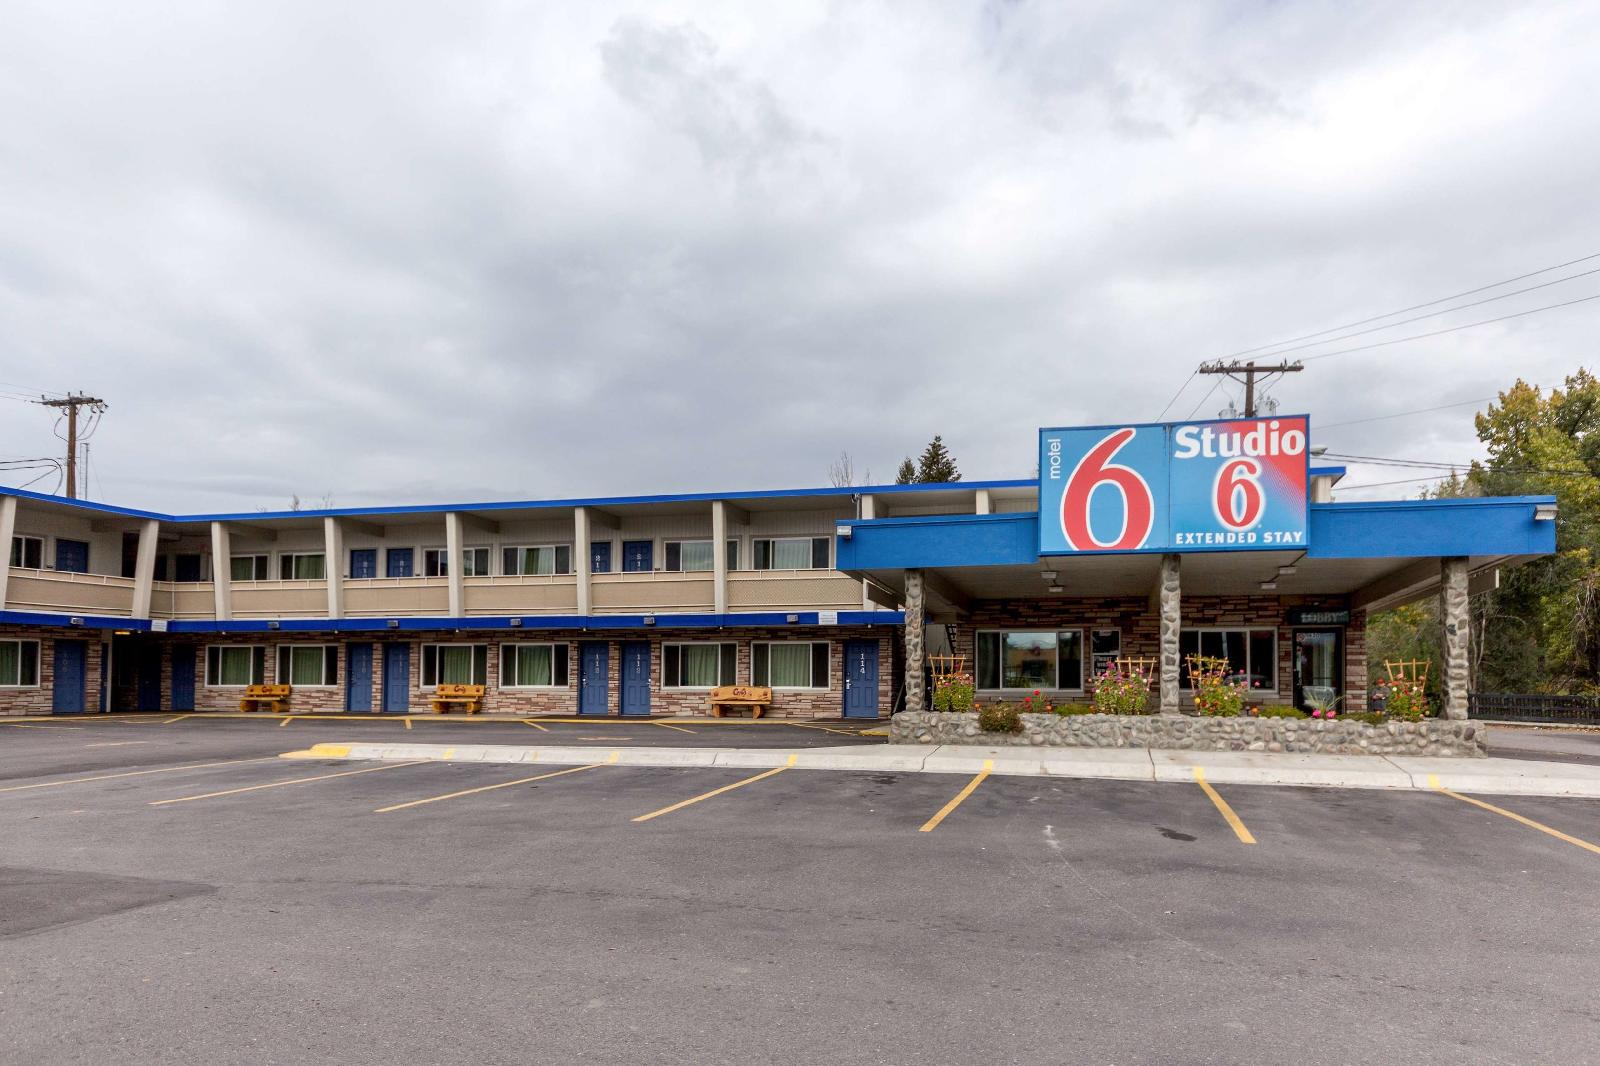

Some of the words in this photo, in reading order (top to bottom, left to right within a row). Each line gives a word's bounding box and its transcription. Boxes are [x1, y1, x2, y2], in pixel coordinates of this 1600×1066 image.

[1174, 420, 1305, 459] Studio
[1048, 438, 1061, 479] motel
[1060, 427, 1154, 551] 6
[1213, 456, 1265, 531] 6
[1175, 532, 1256, 545] EXTENDED
[1263, 531, 1302, 543] STAY
